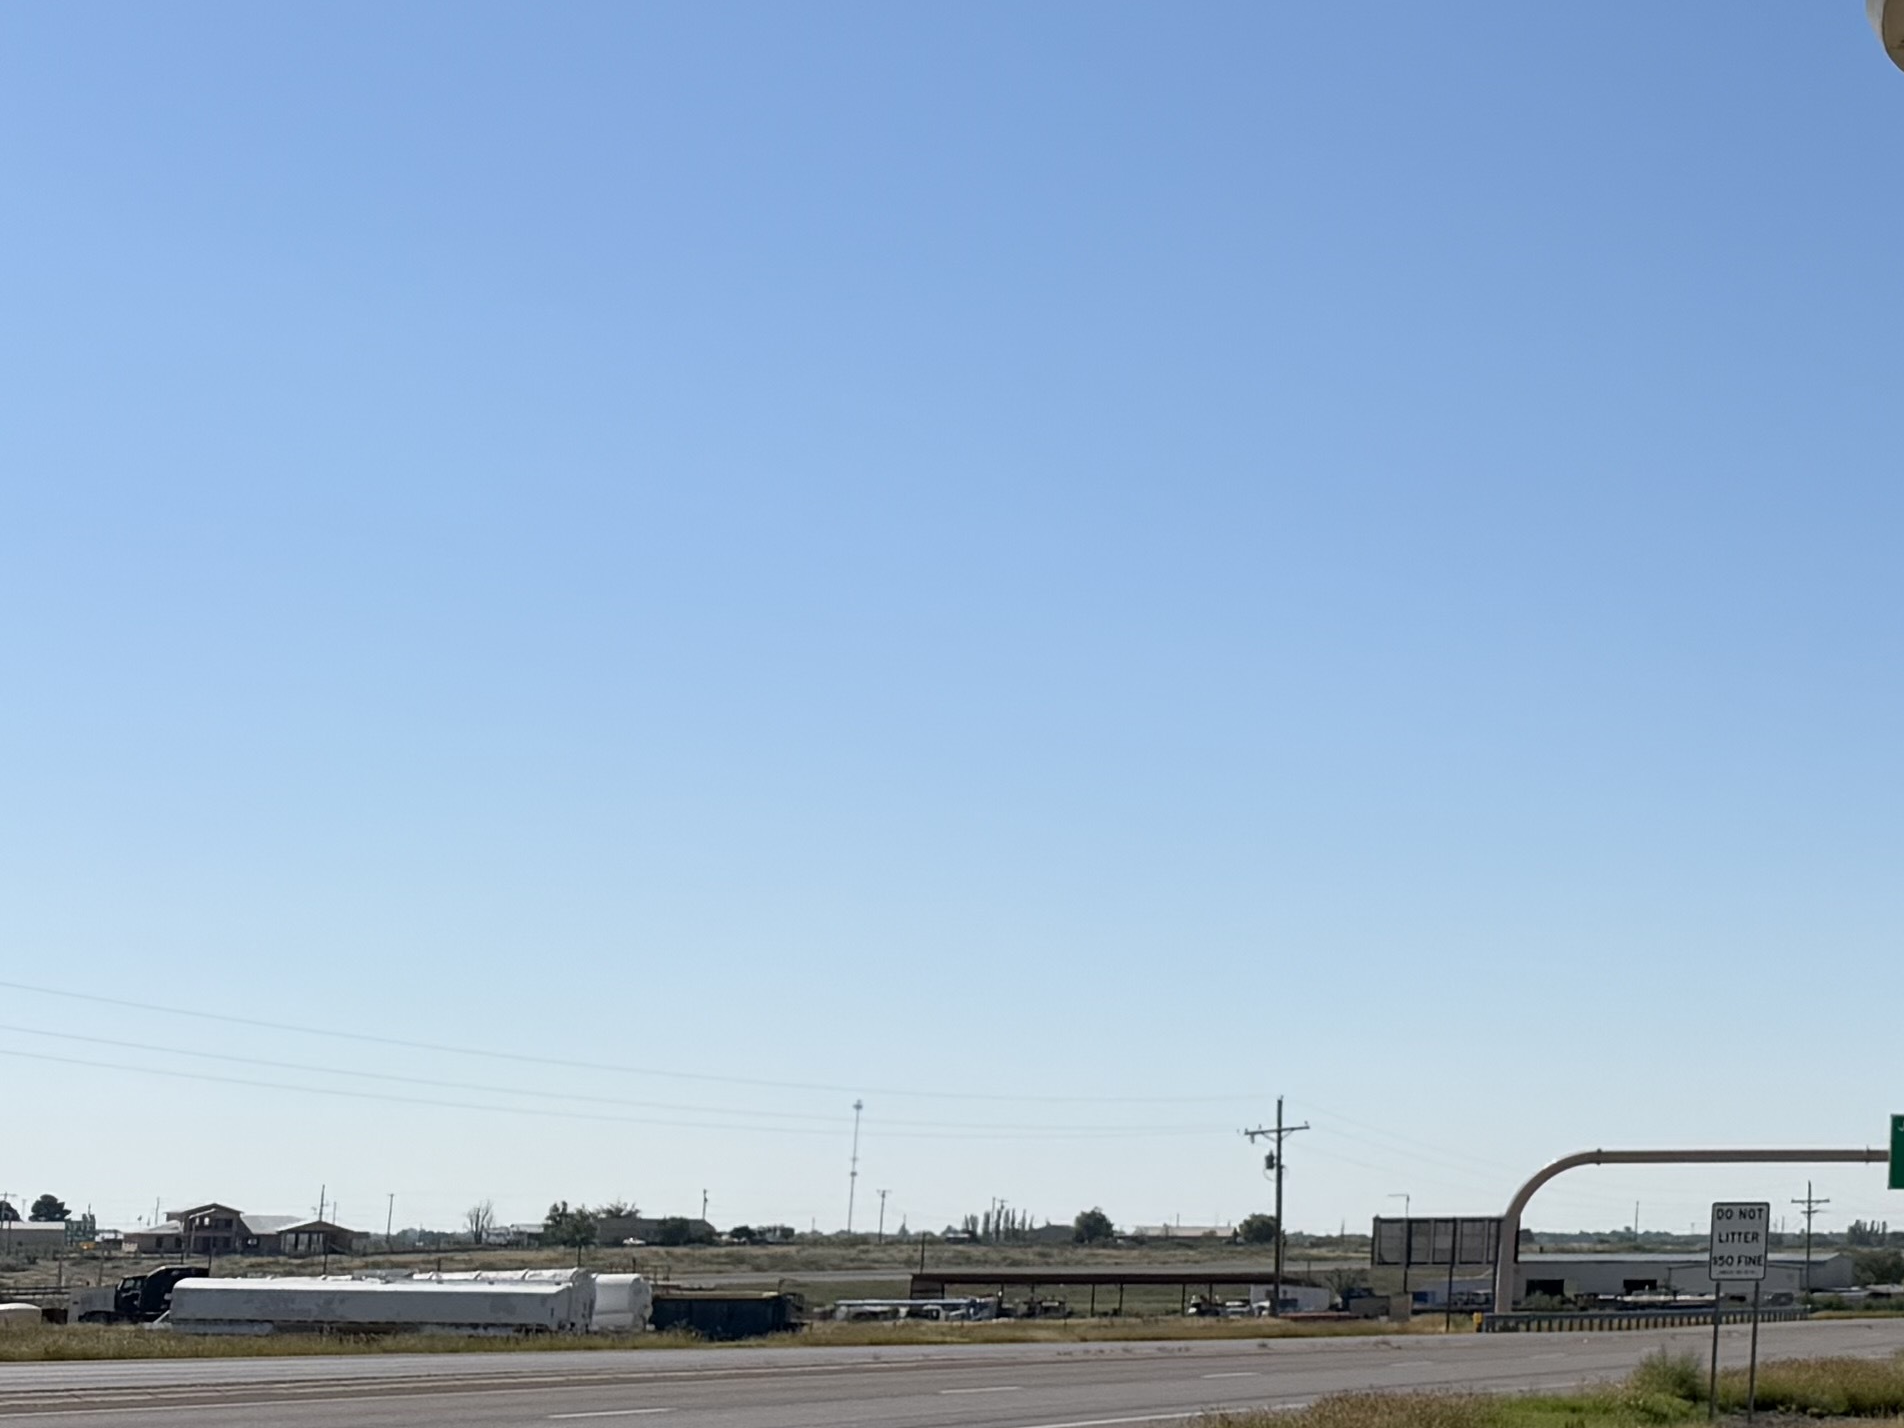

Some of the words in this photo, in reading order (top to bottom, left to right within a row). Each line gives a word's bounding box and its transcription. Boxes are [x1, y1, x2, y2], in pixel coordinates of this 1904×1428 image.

[1716, 1207, 1733, 1221] DO
[1738, 1207, 1764, 1221] NOT
[1718, 1231, 1760, 1244] LITTER
[1712, 1254, 1734, 1267] $50
[1737, 1254, 1764, 1267] FINE
